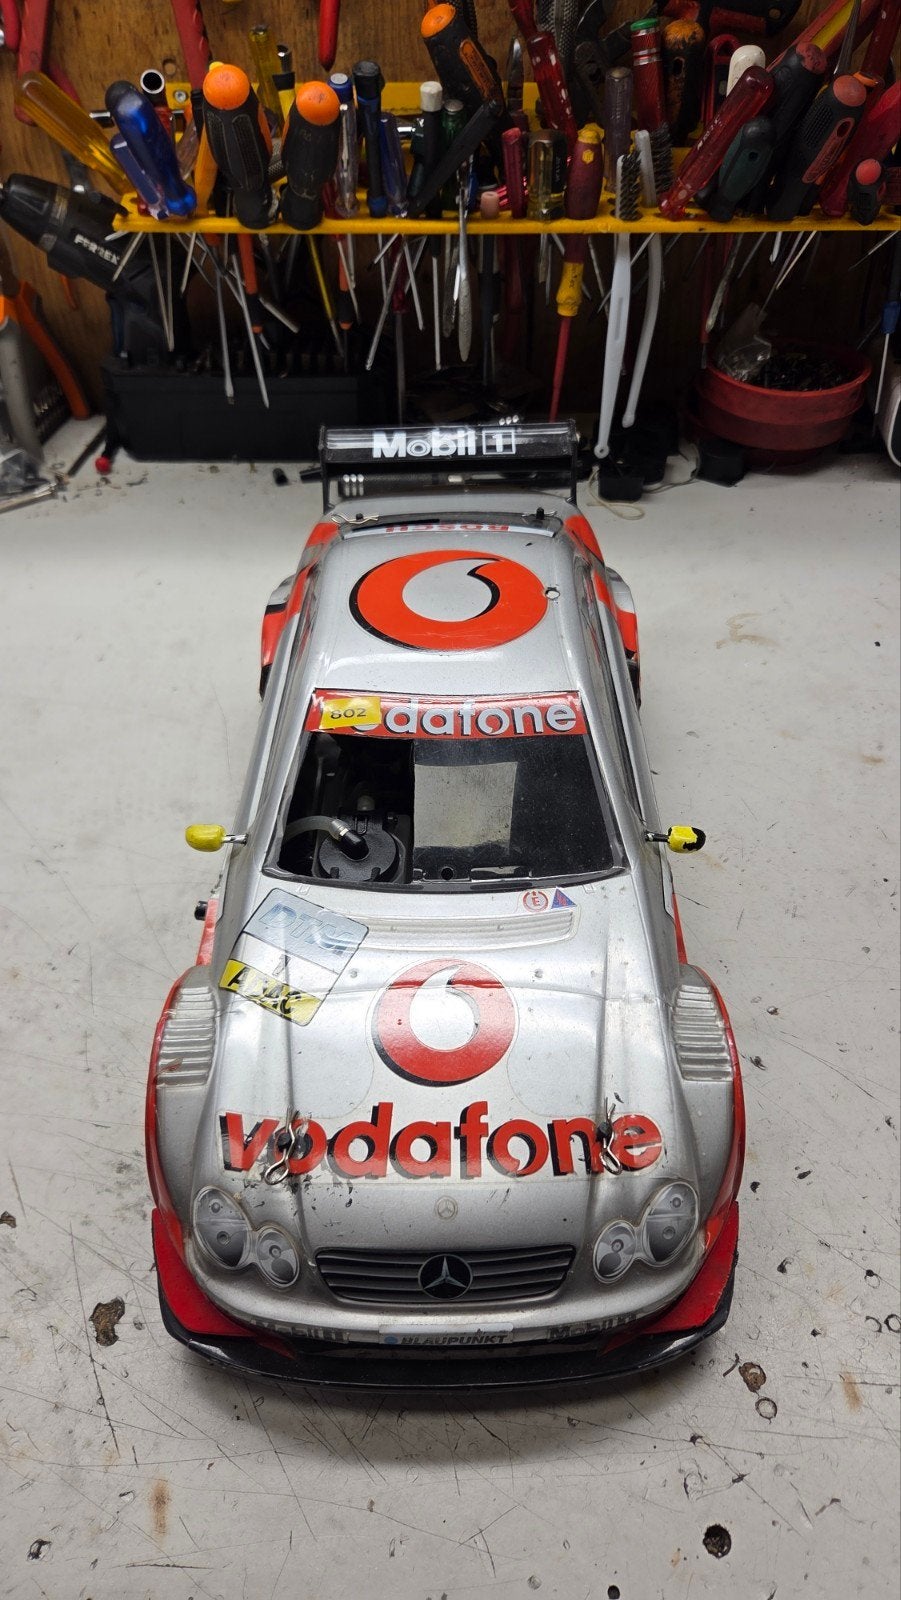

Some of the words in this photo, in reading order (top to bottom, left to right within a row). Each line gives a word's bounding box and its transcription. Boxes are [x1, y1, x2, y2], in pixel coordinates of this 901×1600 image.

[373, 427, 476, 458] Mobil
[330, 707, 367, 720] 802
[330, 697, 577, 735] dafone
[219, 1101, 663, 1178] vodafone
[401, 1334, 508, 1345] BLAUPUNKT
